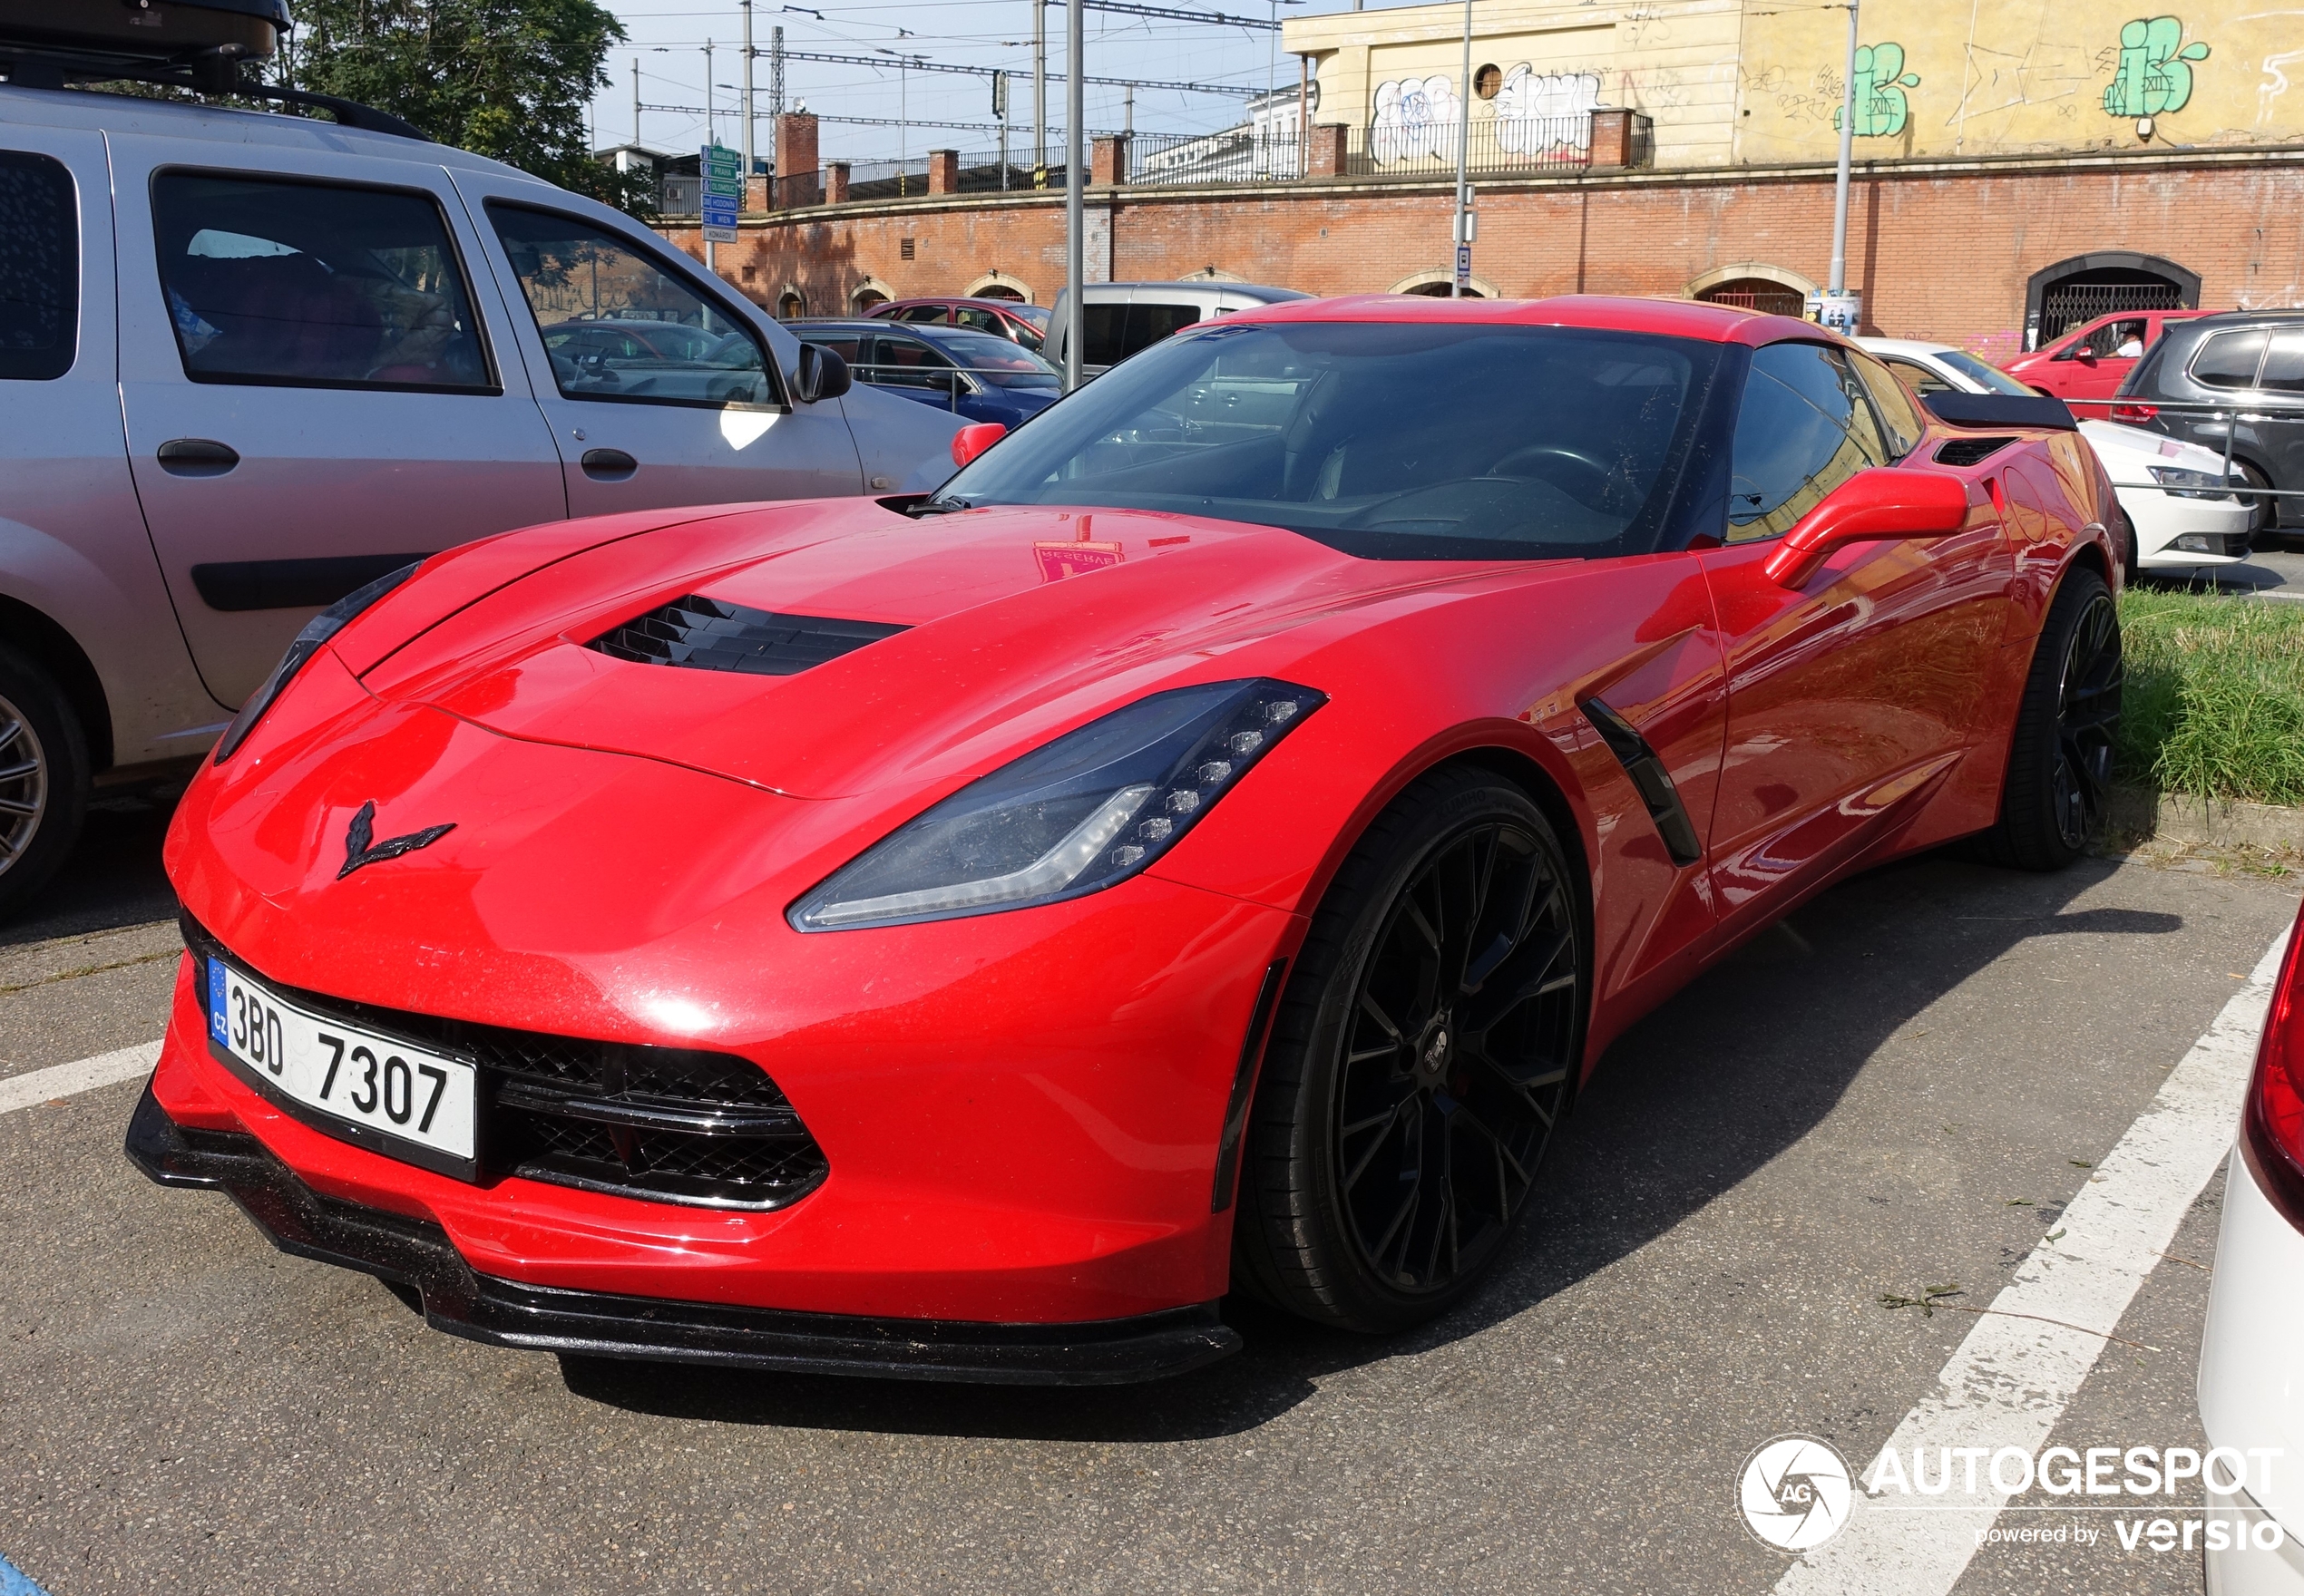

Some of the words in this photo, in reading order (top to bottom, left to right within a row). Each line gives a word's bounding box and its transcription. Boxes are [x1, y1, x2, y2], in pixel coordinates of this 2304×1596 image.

[714, 167, 731, 176] PRAHA
[711, 183, 736, 193] OLOMOUC
[712, 199, 736, 209] HODONÍN
[704, 214, 710, 222] 52
[718, 215, 731, 224] WIEN
[1435, 789, 1487, 822] KUMHO
[213, 1011, 227, 1036] CZ
[232, 985, 284, 1076] 3BD
[317, 1032, 447, 1134] 7307
